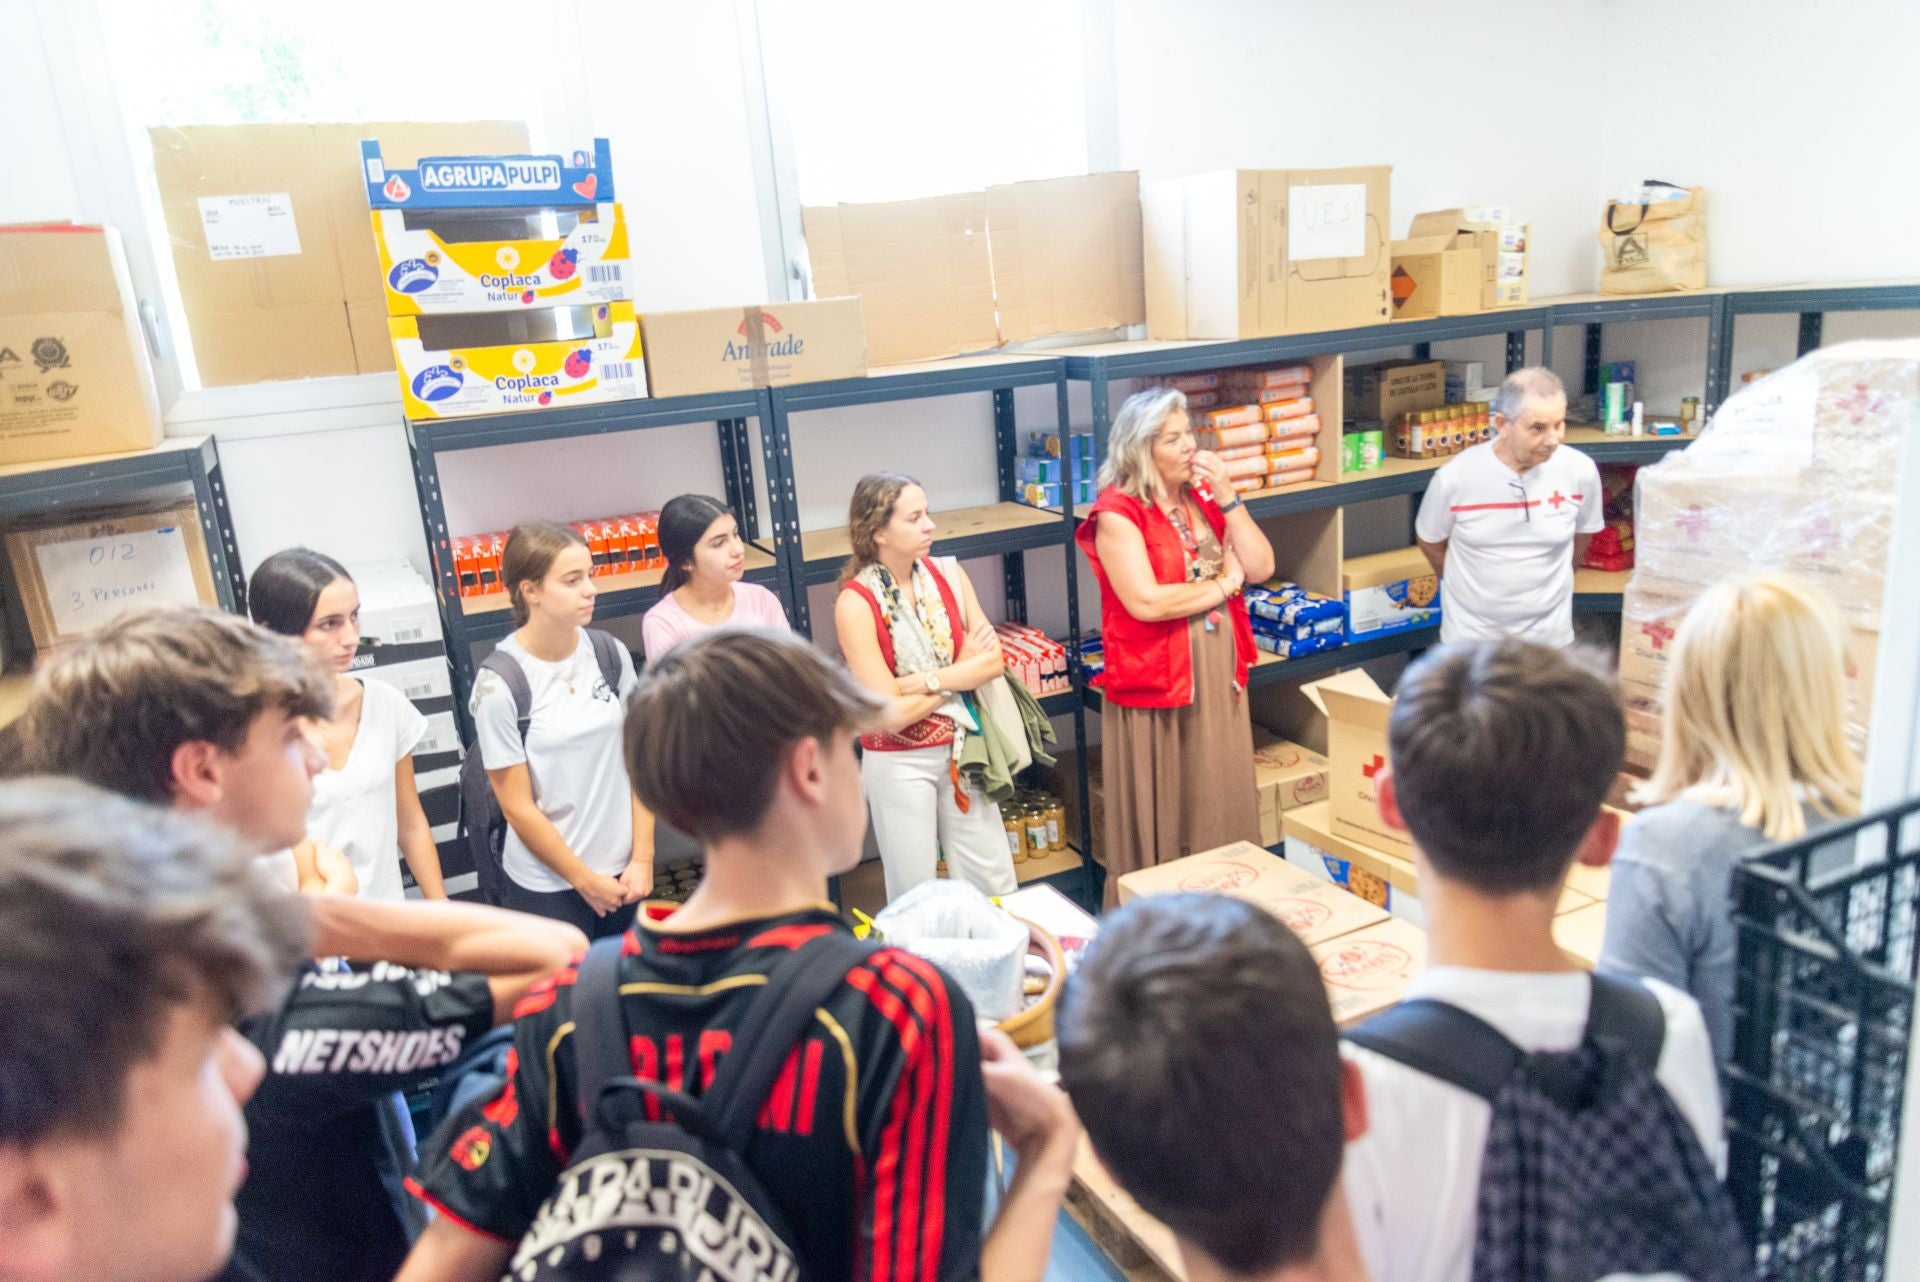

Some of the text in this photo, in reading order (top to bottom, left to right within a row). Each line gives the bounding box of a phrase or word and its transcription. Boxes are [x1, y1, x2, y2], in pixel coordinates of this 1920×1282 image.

[424, 165, 558, 187] AGRUPAPULPI
[1303, 201, 1352, 231] UES
[480, 273, 541, 292] Coplaca
[487, 292, 518, 302] Natur
[721, 333, 804, 362] Anrade
[495, 374, 560, 393] Coplaca
[503, 393, 535, 404] Natur
[89, 543, 136, 565] 012
[71, 591, 85, 611] 3
[272, 1024, 466, 1074] NETSHOES
